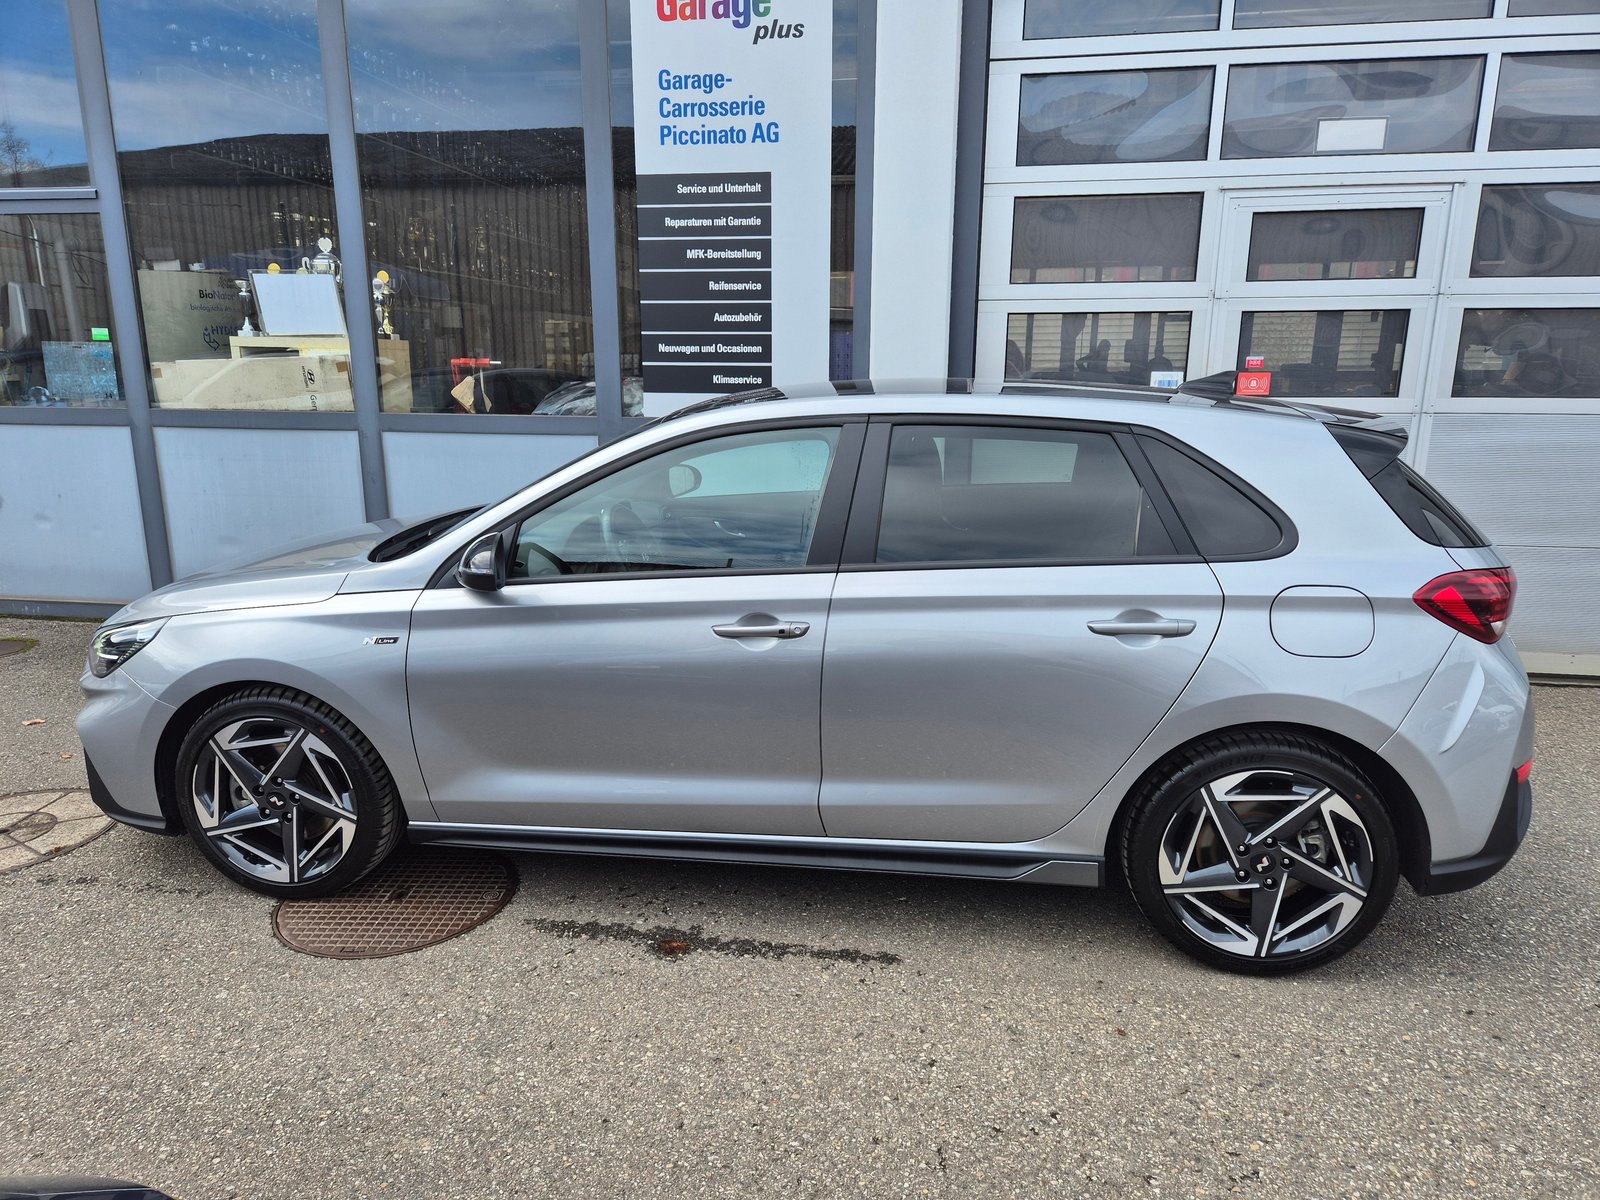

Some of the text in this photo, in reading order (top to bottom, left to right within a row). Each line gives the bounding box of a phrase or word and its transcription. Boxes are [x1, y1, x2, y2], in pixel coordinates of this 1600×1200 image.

[752, 19, 805, 45] plus
[658, 69, 733, 94] Garage-
[659, 95, 766, 118] Carrosserie
[659, 121, 780, 146] Piccinato AG
[676, 182, 762, 194] Service und Unterhalt
[664, 216, 762, 229] Reparaturen mit Garantie
[686, 249, 762, 260] MFK-Bereitstellung
[708, 280, 762, 291] Reifenservice
[713, 312, 763, 322] Autozubehör
[658, 343, 763, 355] Neuwagen und Occasionen
[712, 374, 763, 384] Klimaservice
